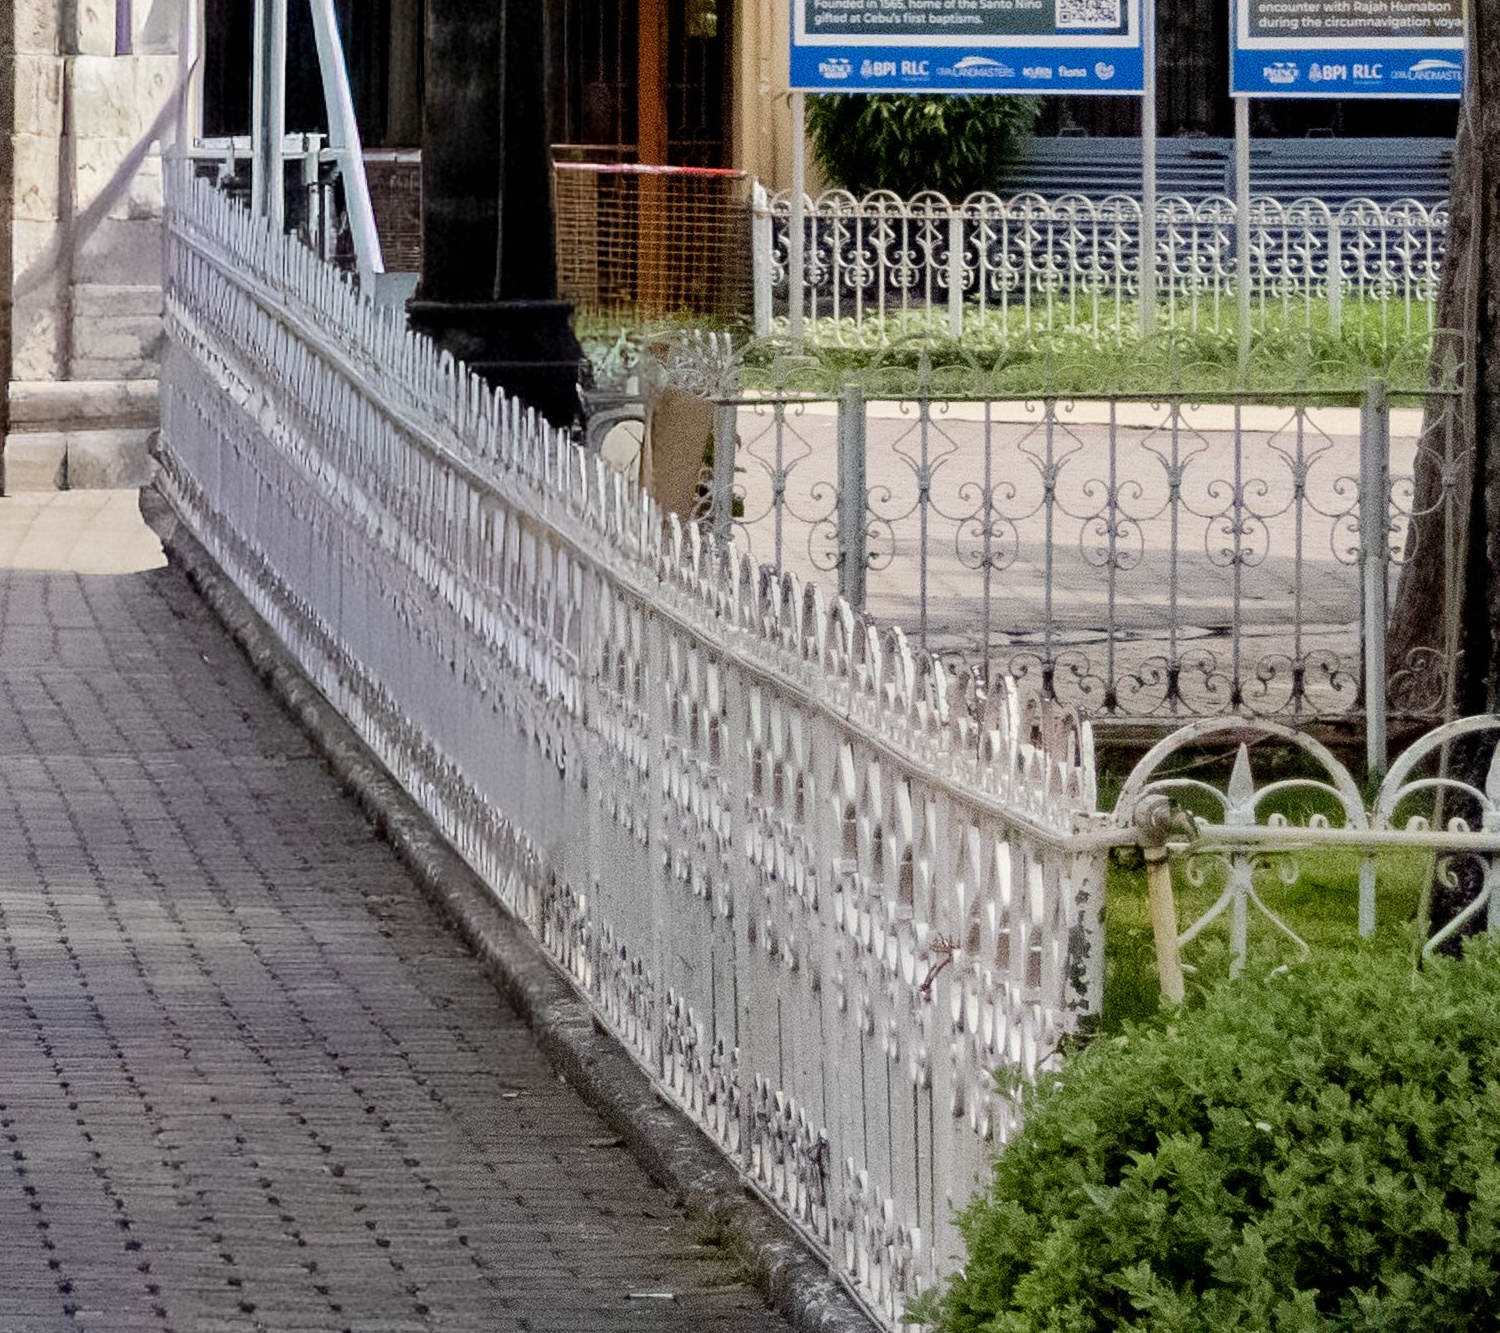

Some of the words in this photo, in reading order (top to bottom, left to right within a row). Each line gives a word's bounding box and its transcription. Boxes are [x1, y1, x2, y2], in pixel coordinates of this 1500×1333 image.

[1258, 2, 1321, 13] encounter
[1322, 1, 1352, 13] with
[1353, 1, 1388, 15] Rajah
[1390, 1, 1452, 13] Humabon
[814, 13, 848, 25] gifted
[849, 14, 862, 23] at
[902, 12, 927, 24] first
[1258, 17, 1300, 31] during
[1301, 17, 1322, 28] the
[1324, 17, 1432, 31] circumnavigation
[1322, 64, 1347, 80] BPI
[1352, 63, 1384, 79] RLC
